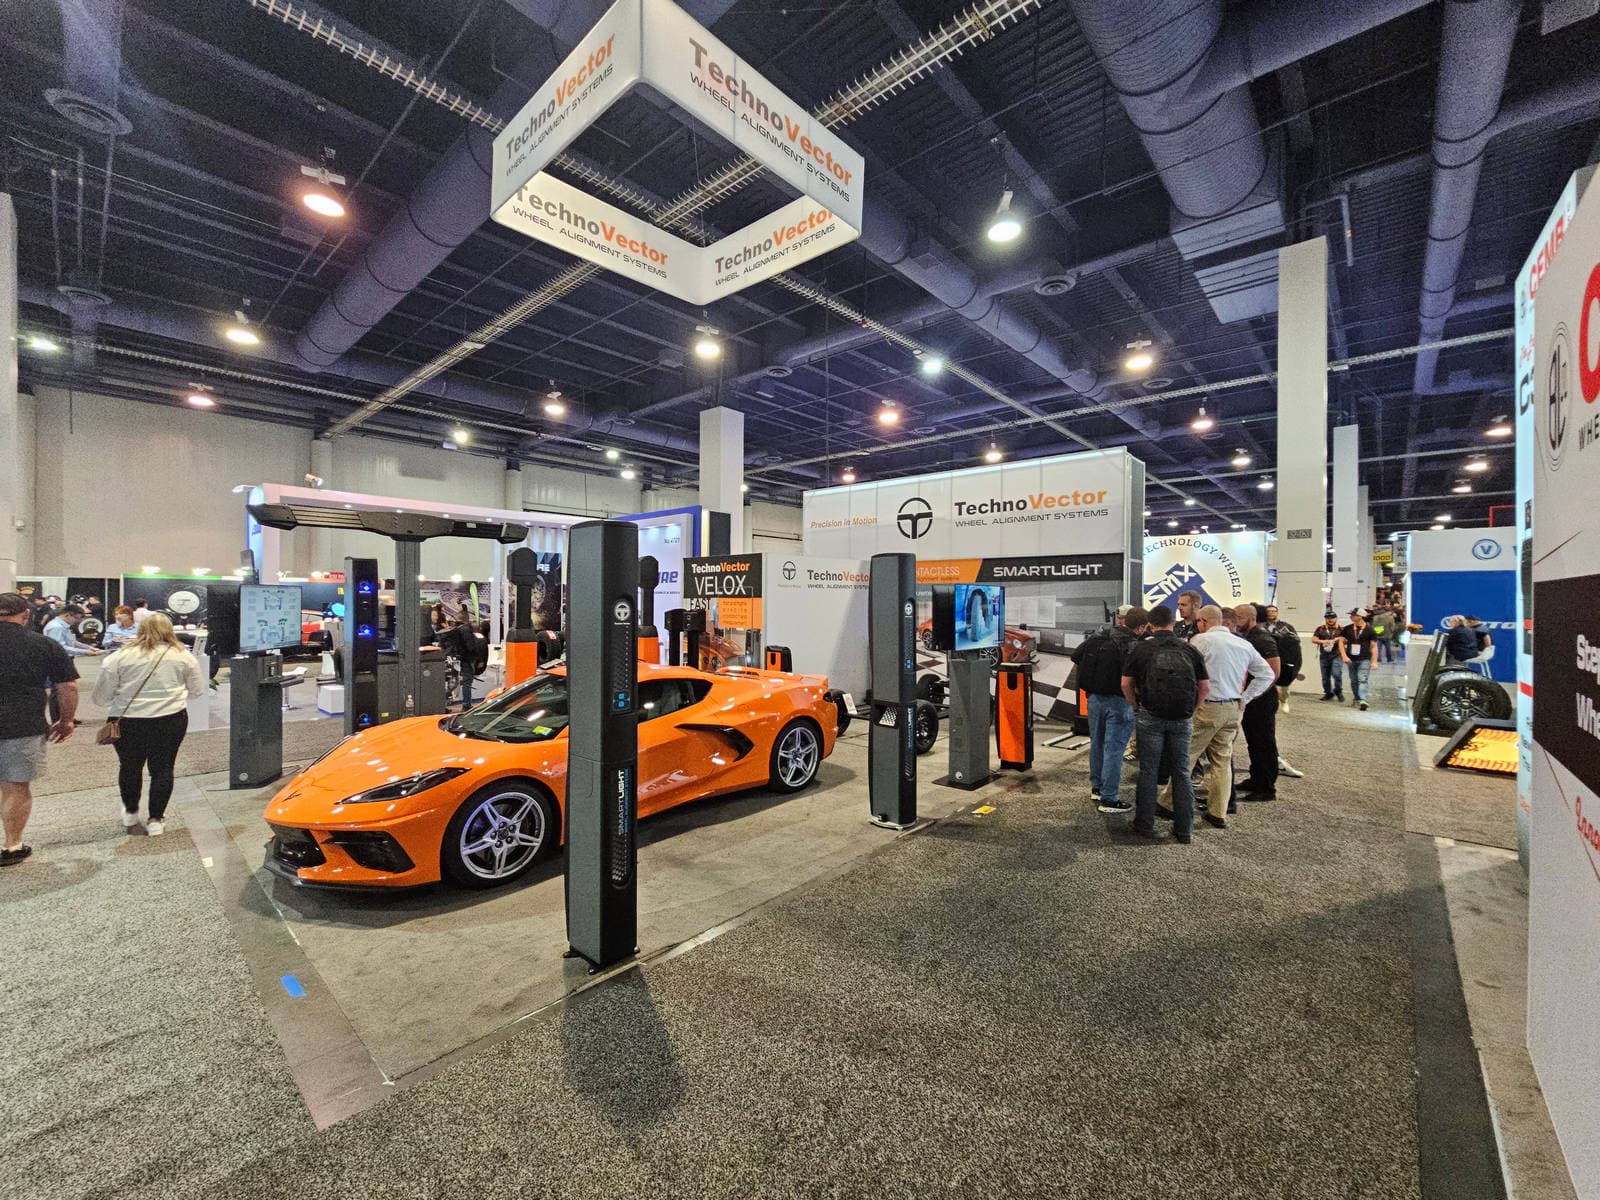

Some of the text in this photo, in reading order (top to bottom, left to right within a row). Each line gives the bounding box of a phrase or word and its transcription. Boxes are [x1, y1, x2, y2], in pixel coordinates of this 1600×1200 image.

[506, 33, 616, 161] TechnoVector
[529, 106, 571, 154] ALIGNMENT
[571, 64, 613, 112] SYSTEMS
[689, 37, 853, 187] TechnoVector
[690, 71, 850, 203] WHEEL ALIGNMENT SYSTEMS
[512, 205, 668, 280] WHEEL ALIGNMENT SYSTEMS
[715, 223, 836, 287] WHEEL ALIGNMENT SYSTEMS
[810, 519, 843, 529] Precision
[852, 516, 878, 526] Motion
[954, 489, 1108, 517] TechnoVector
[955, 508, 1109, 528] WHEEL ALIGNMENT SYSTEMS
[690, 561, 751, 574] TechnoVector
[694, 574, 748, 597] VELOX
[807, 569, 872, 582] TechnoVecto
[993, 563, 1103, 577] SMARTLIGHT
[1143, 537, 1242, 598] ECHNOLOGY WHEELS
